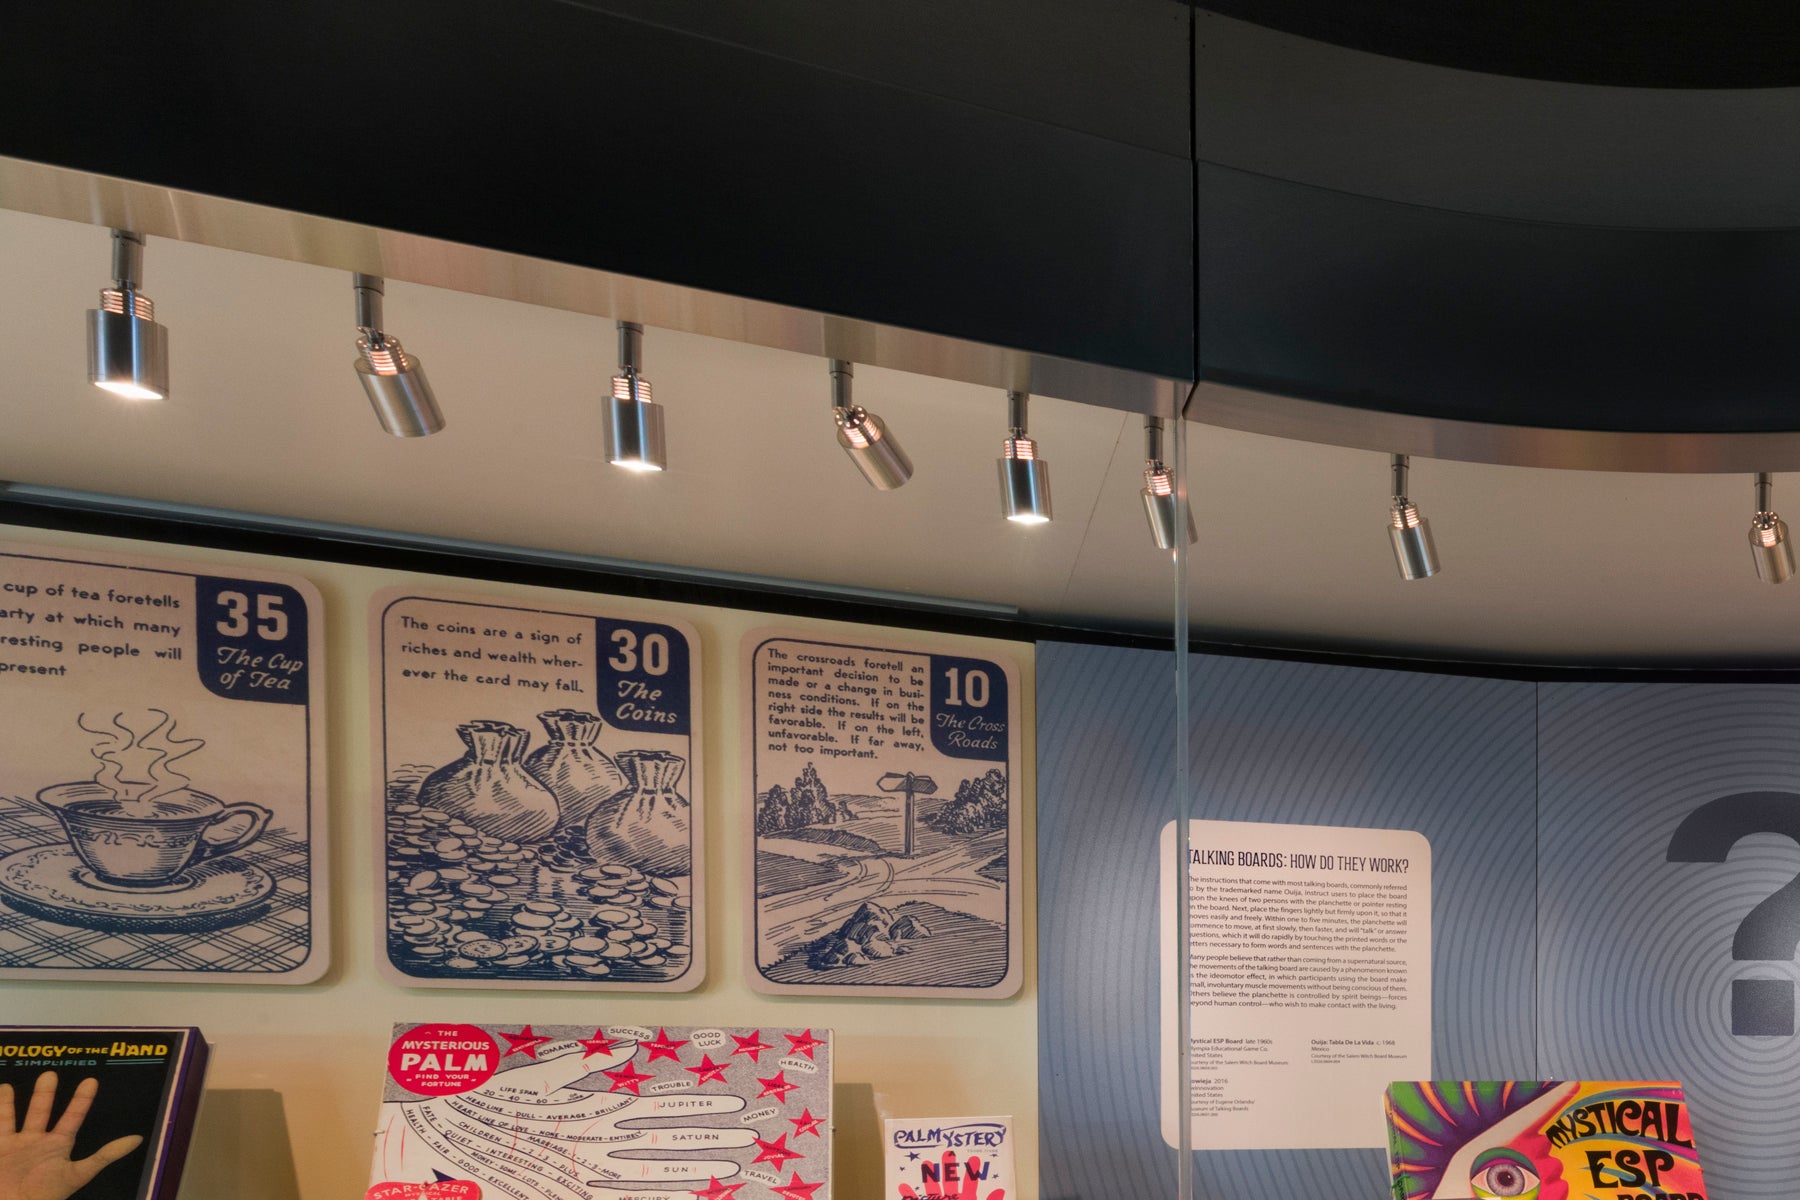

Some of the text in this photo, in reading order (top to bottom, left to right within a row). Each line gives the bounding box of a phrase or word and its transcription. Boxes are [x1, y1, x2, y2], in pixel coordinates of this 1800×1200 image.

[2, 582, 180, 609] cup of tea foretells
[44, 611, 64, 623] at
[72, 612, 124, 629] which
[132, 621, 180, 638] many
[216, 590, 289, 641] 35
[400, 615, 582, 645] The coins are a sign of
[77, 642, 140, 658] people
[154, 646, 182, 660] will
[217, 646, 304, 673] The Cup
[608, 628, 669, 676] 30
[220, 669, 291, 690] of Tea
[944, 667, 990, 708] 10
[617, 679, 663, 702] The
[615, 702, 678, 725] Coins
[936, 712, 1006, 733] The Cross
[948, 731, 998, 750] Roads
[1237, 850, 1287, 868] BOARDS:
[1289, 853, 1316, 869] HOW
[1319, 854, 1334, 870] DO
[1336, 855, 1366, 871] THEY
[1368, 857, 1409, 873] WORK?
[609, 1027, 651, 1041] SUCCESS
[692, 1032, 721, 1040] GOOD
[698, 1039, 722, 1047] LUCK
[110, 1042, 168, 1057] HAND
[401, 1040, 490, 1050] MYSTERIOUS
[538, 1041, 580, 1058] ROMANCE
[14, 1059, 97, 1067] SIMPLIFIED
[400, 1053, 488, 1071] PALM
[780, 1059, 815, 1071] HEALTH
[651, 1080, 691, 1092] TROUBLE
[659, 1100, 713, 1108] JUPITER
[743, 1108, 777, 1123] MONEY
[1545, 1099, 1694, 1150] MYSTICAL
[671, 1133, 720, 1141] SATURN
[893, 1122, 1007, 1149] PALMYSTERY
[744, 1170, 778, 1184] TRAVEL
[921, 1161, 990, 1184] NEW
[1585, 1150, 1675, 1189] ESP
